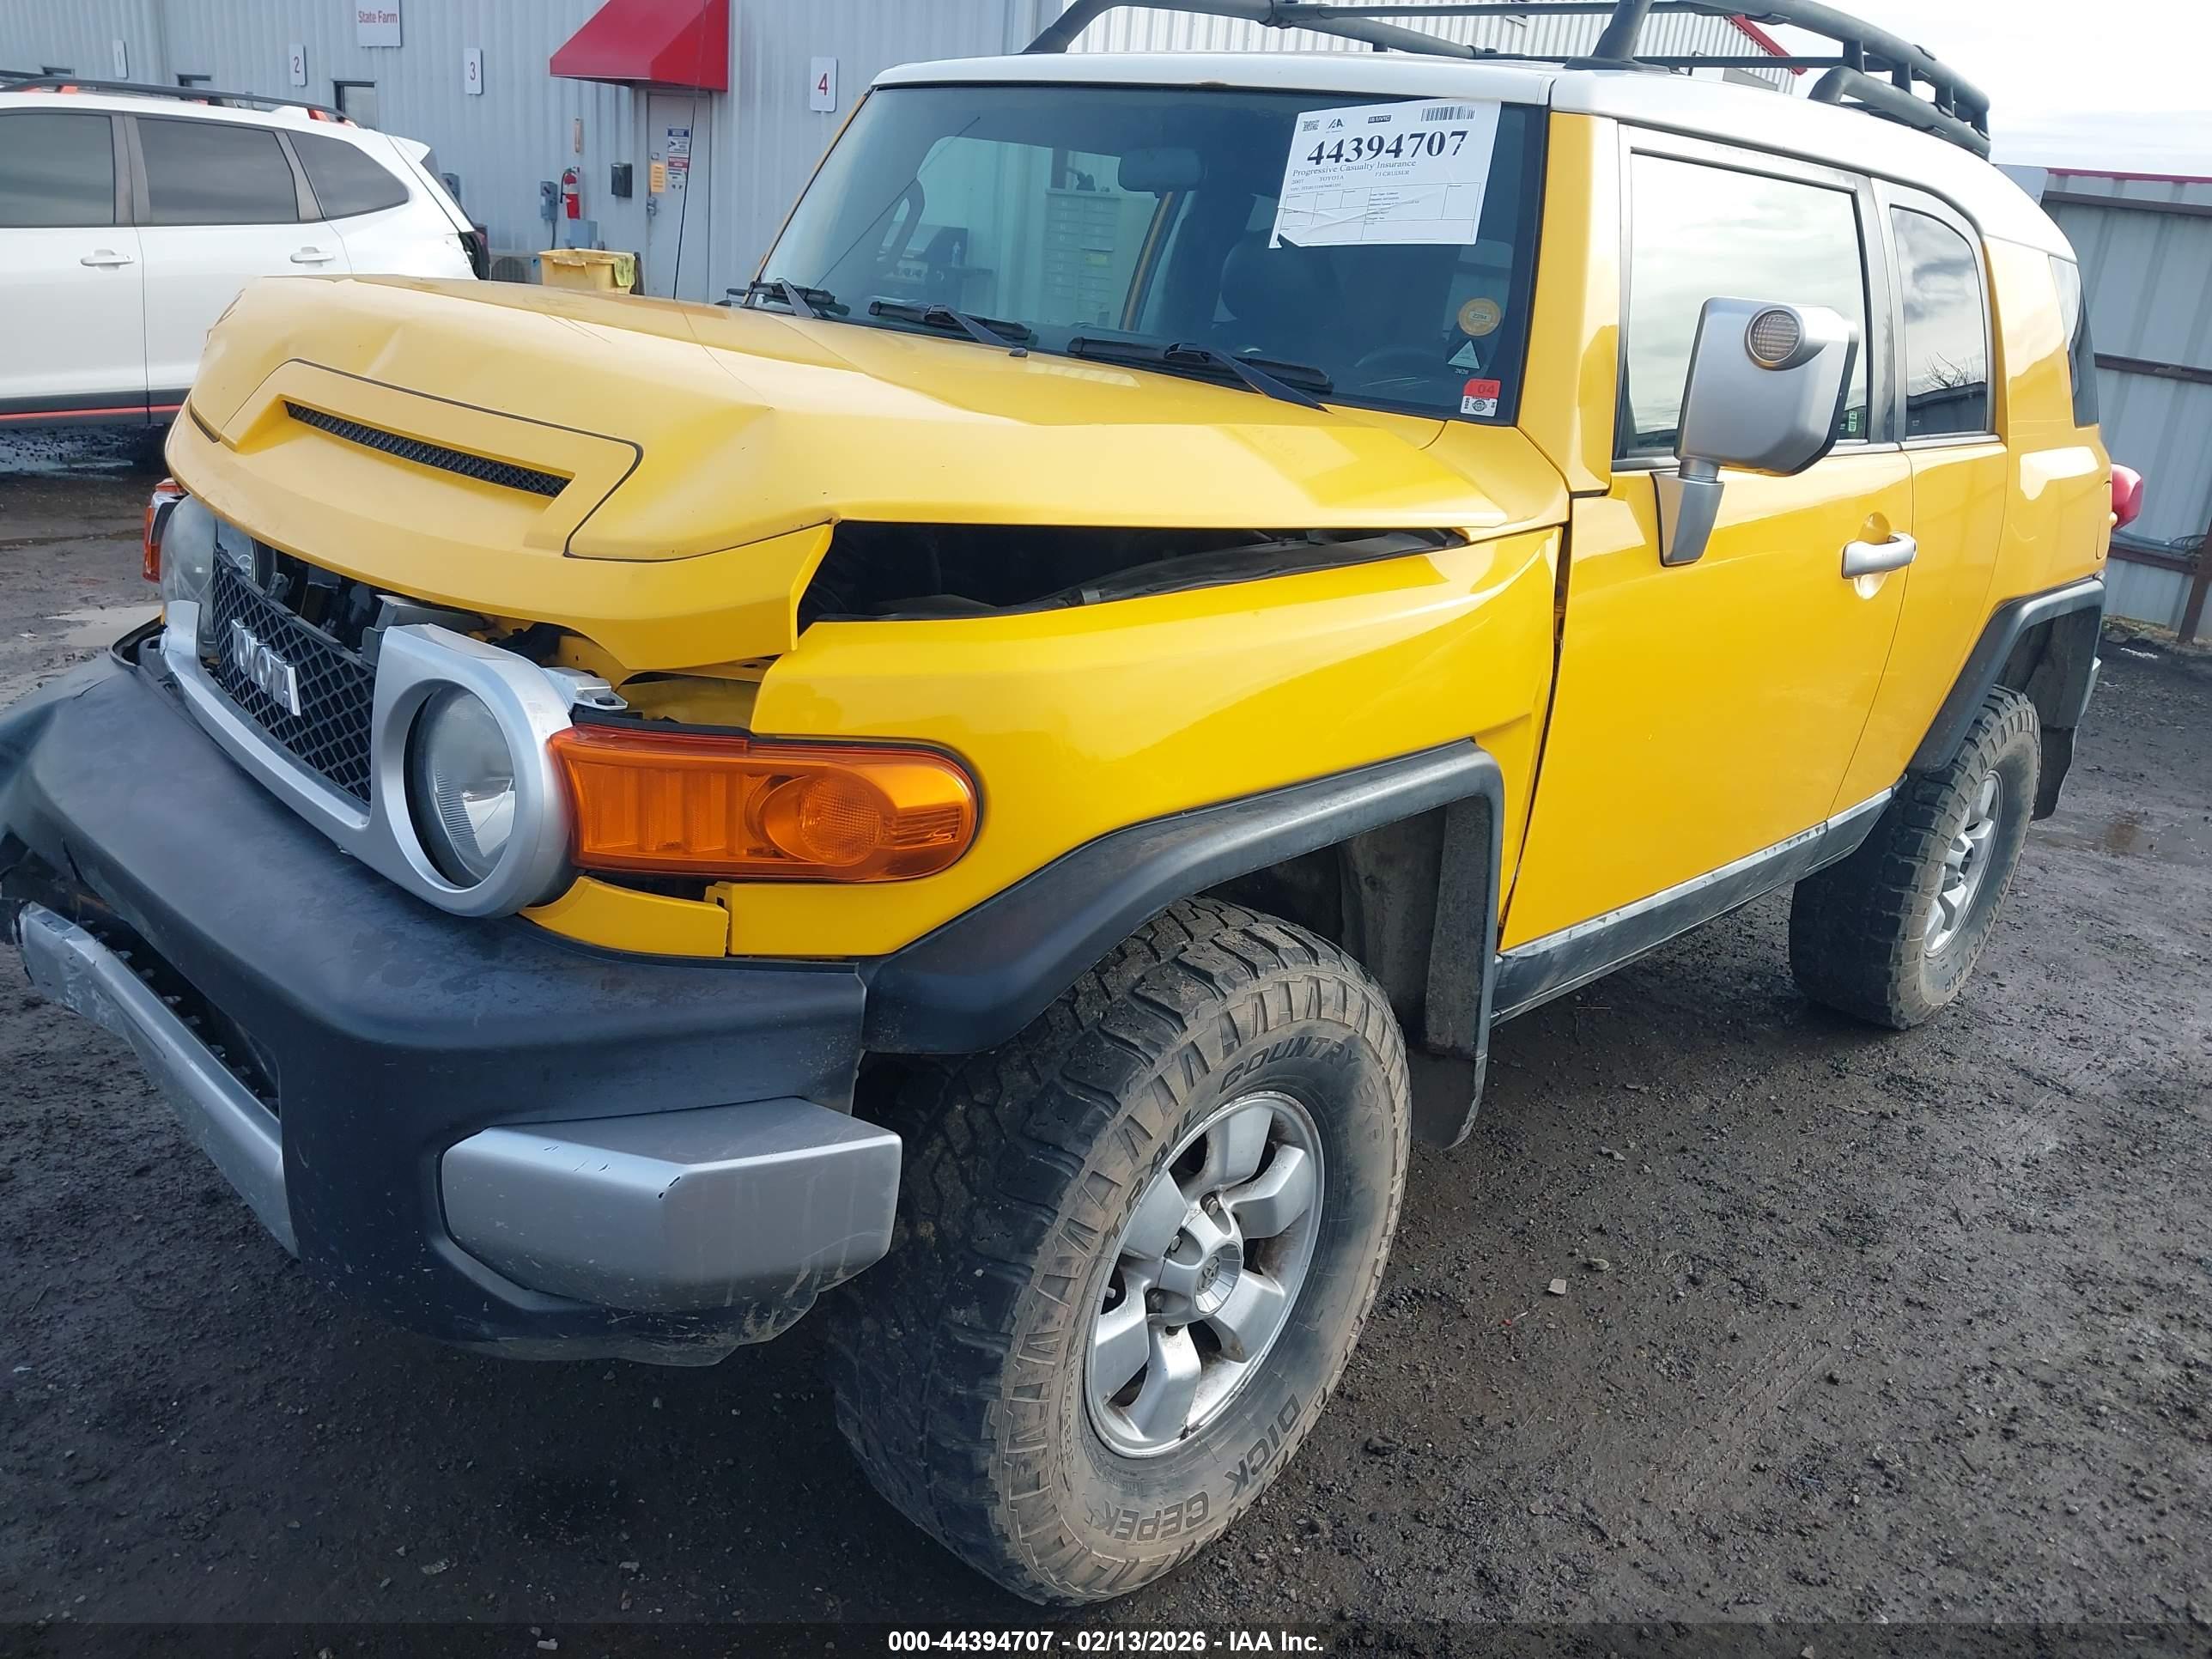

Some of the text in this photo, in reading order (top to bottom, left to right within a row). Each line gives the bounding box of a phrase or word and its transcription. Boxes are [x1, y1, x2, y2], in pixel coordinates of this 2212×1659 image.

[357, 9, 398, 24] State Farm
[293, 56, 301, 74] 2
[469, 61, 477, 81] 3
[817, 72, 829, 96] 4
[1306, 130, 1469, 166] 44394707
[1292, 160, 1417, 177] Progressive Casualty Insurance
[1218, 1036, 1362, 1095] COUNTRY
[1089, 1393, 1302, 1542] DICK CEPEK
